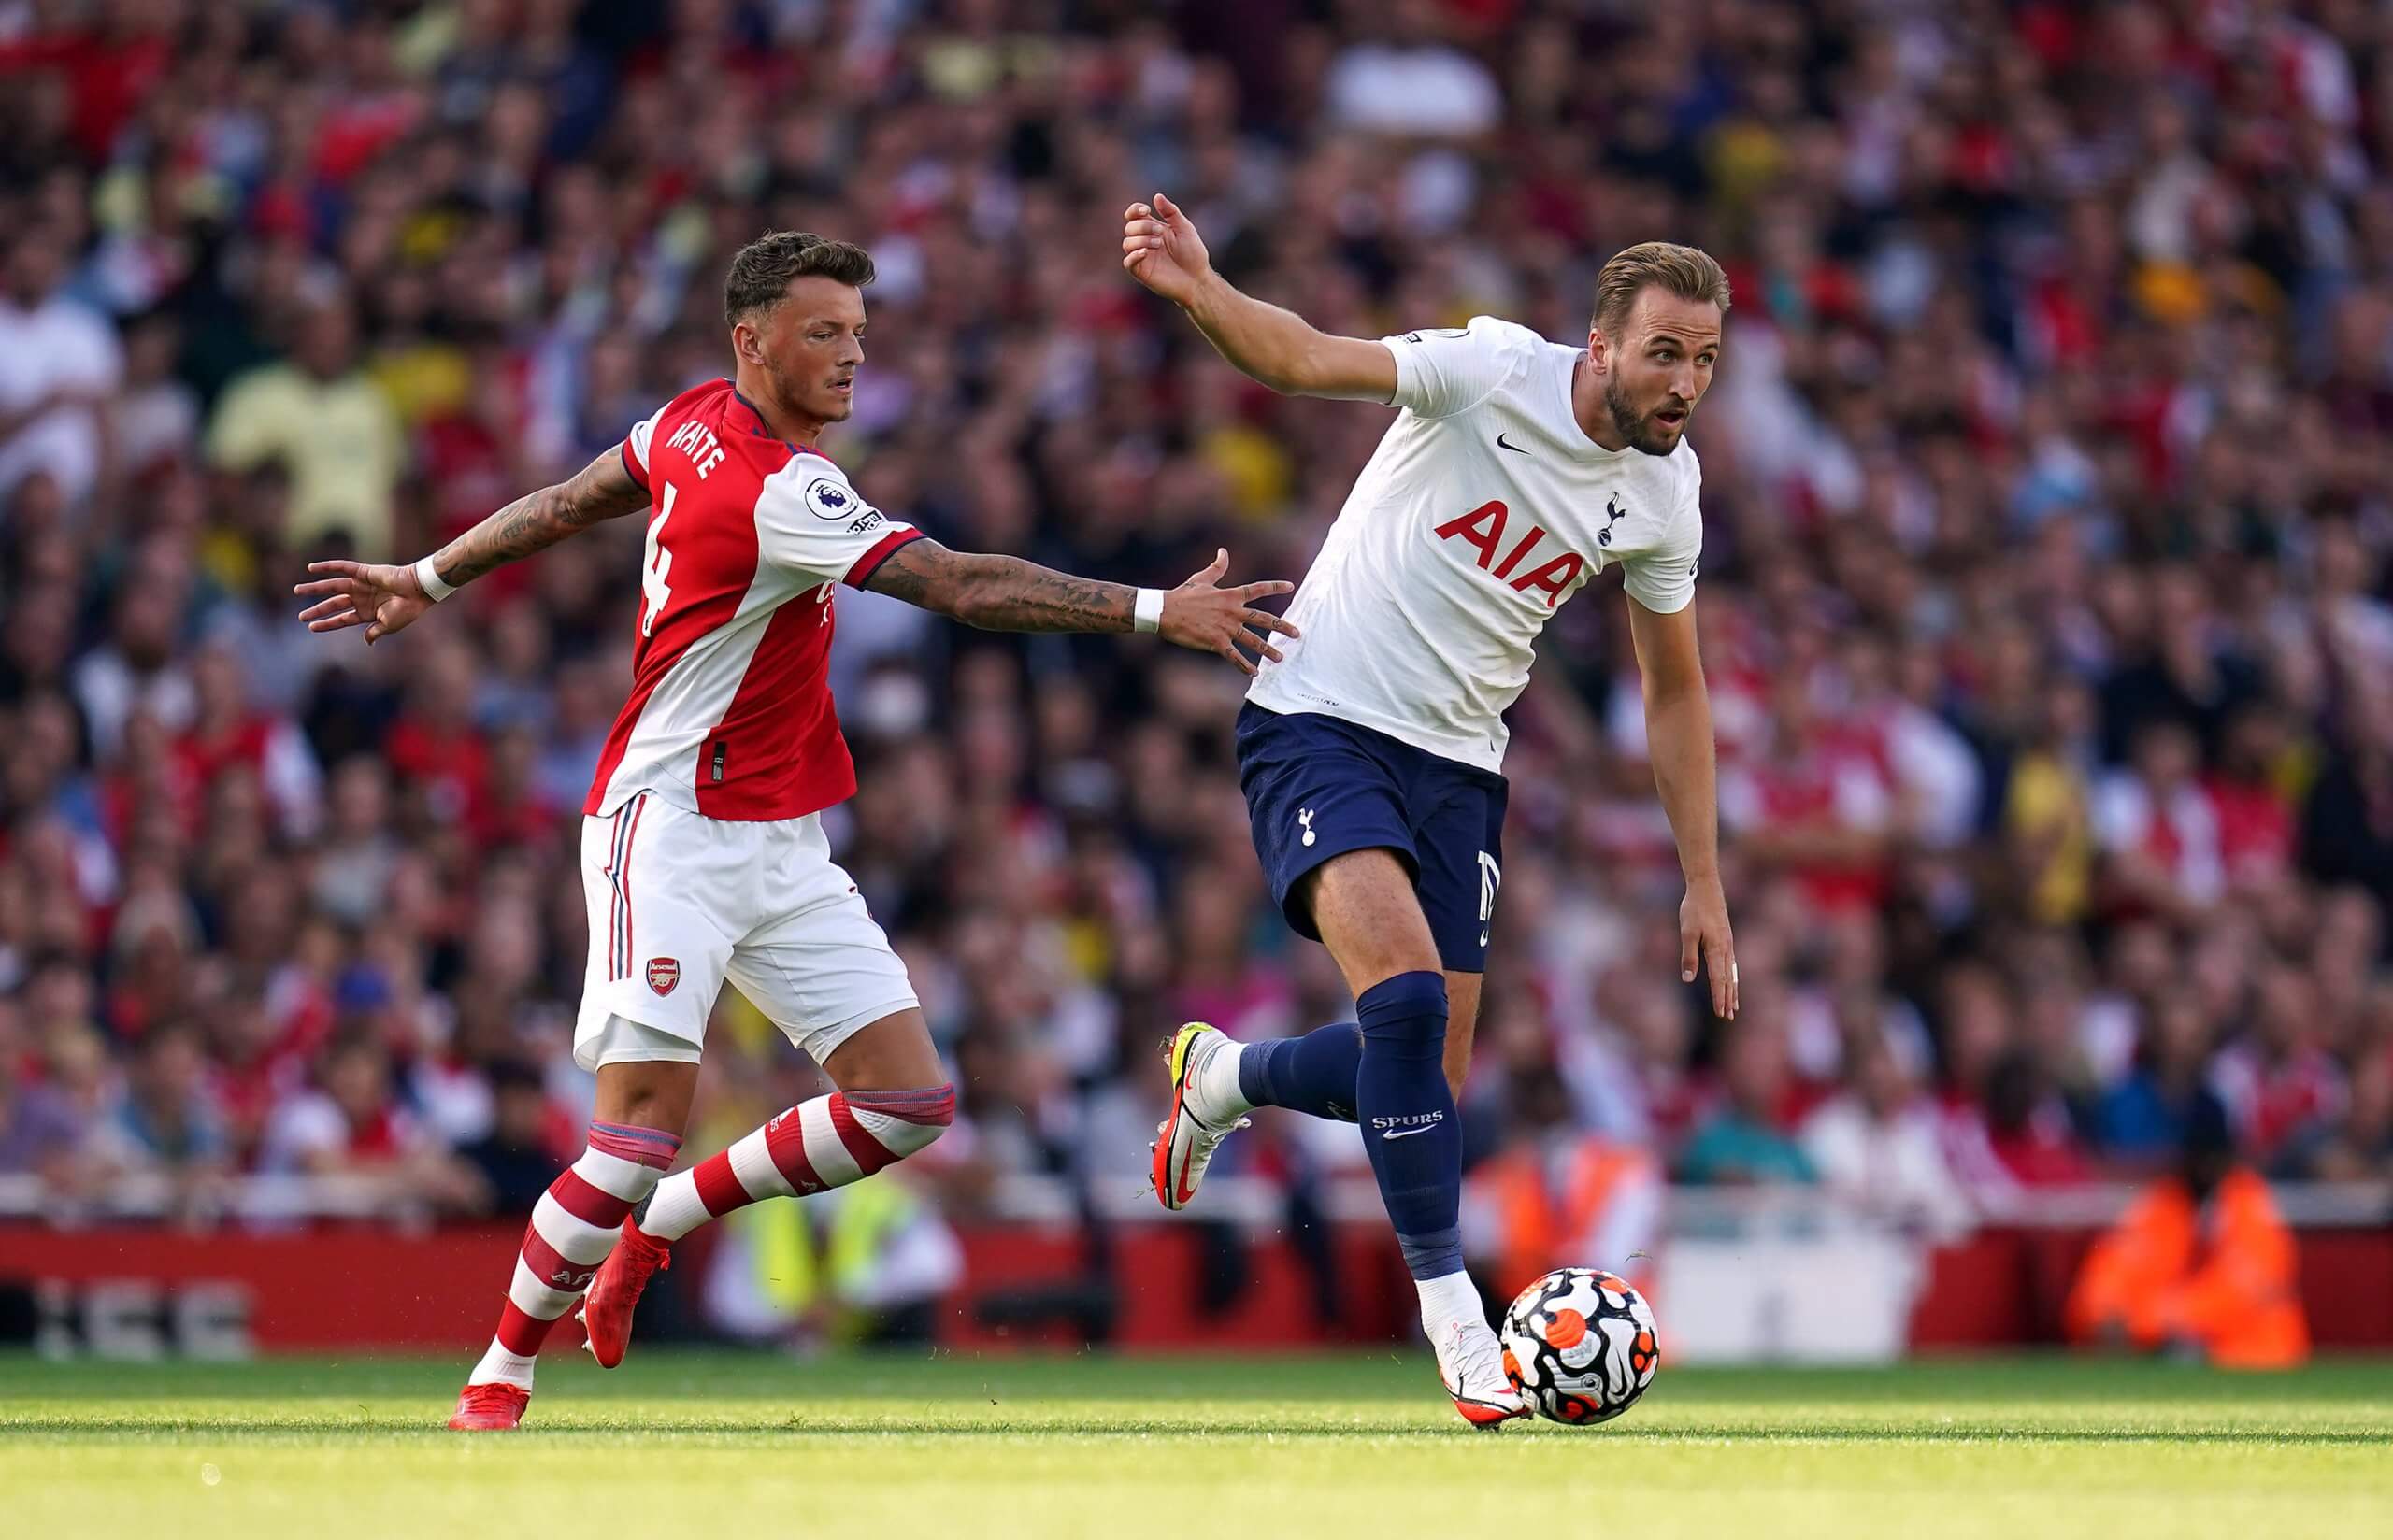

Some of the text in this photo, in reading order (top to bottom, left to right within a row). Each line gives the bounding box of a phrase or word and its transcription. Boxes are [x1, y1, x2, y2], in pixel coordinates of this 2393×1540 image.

[642, 480, 678, 637] 4
[1434, 500, 1584, 607] AIA
[1372, 1110, 1443, 1129] SPURS
